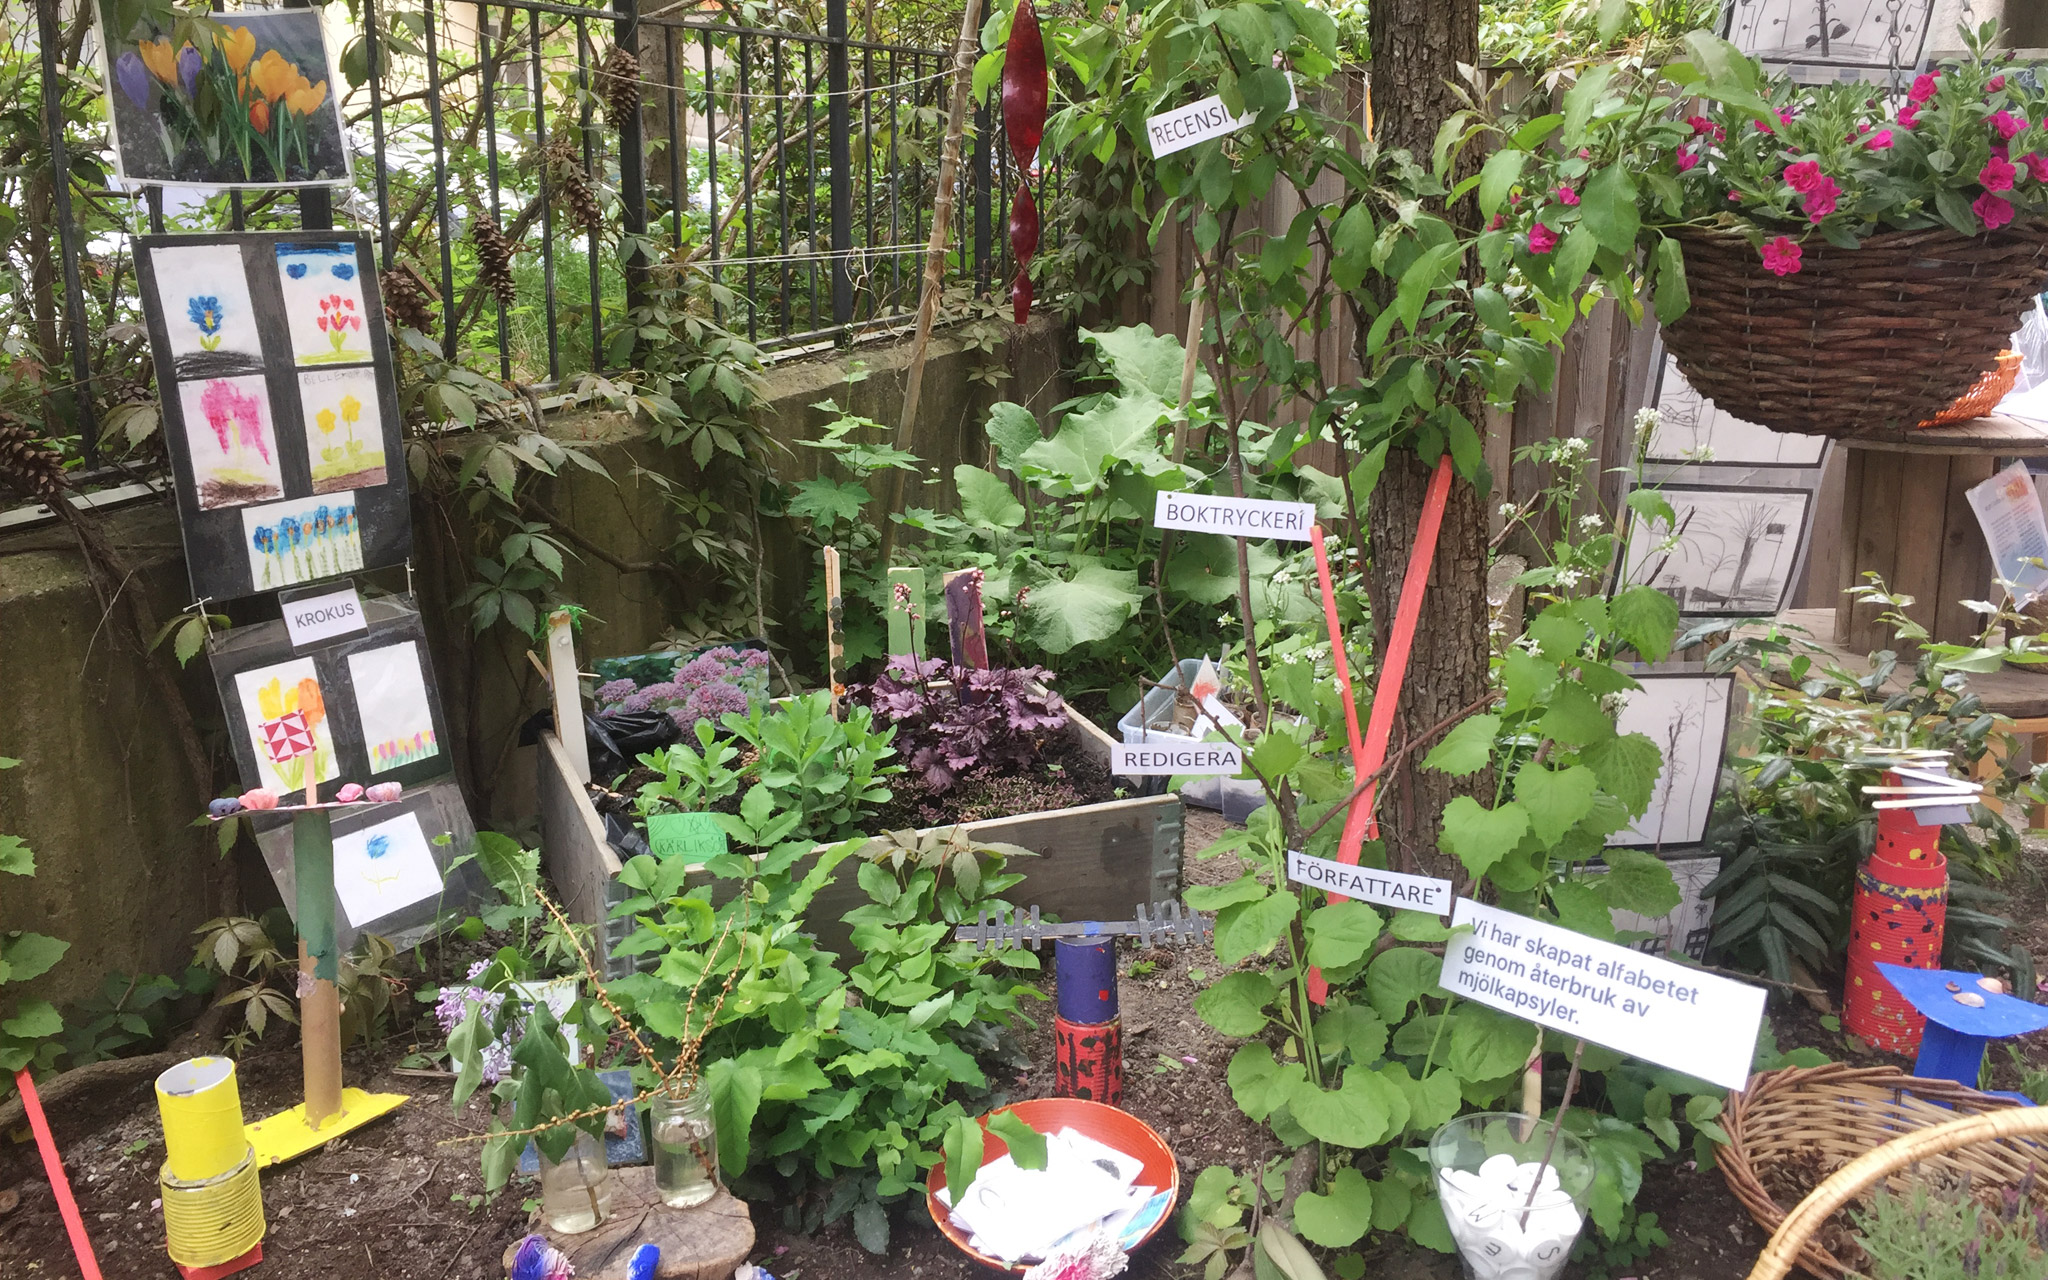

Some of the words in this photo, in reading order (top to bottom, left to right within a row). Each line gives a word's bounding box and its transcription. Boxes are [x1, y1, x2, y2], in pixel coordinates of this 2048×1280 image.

[1154, 104, 1229, 146] RECENSI
[1167, 503, 1304, 531] BOKTRYCKERI
[295, 603, 355, 629] KROKUS
[1125, 751, 1237, 767] REDIGERA
[1297, 861, 1435, 906] FÖRFATTARE
[1463, 946, 1526, 978] genom
[1530, 963, 1617, 1008] återbruk
[1622, 998, 1651, 1018] av
[1472, 917, 1487, 938] Vi
[1490, 922, 1521, 948] har
[1525, 937, 1592, 972] skapat
[1596, 961, 1700, 1006] alfabetet
[1458, 968, 1580, 1025] mjölkapsyler.
